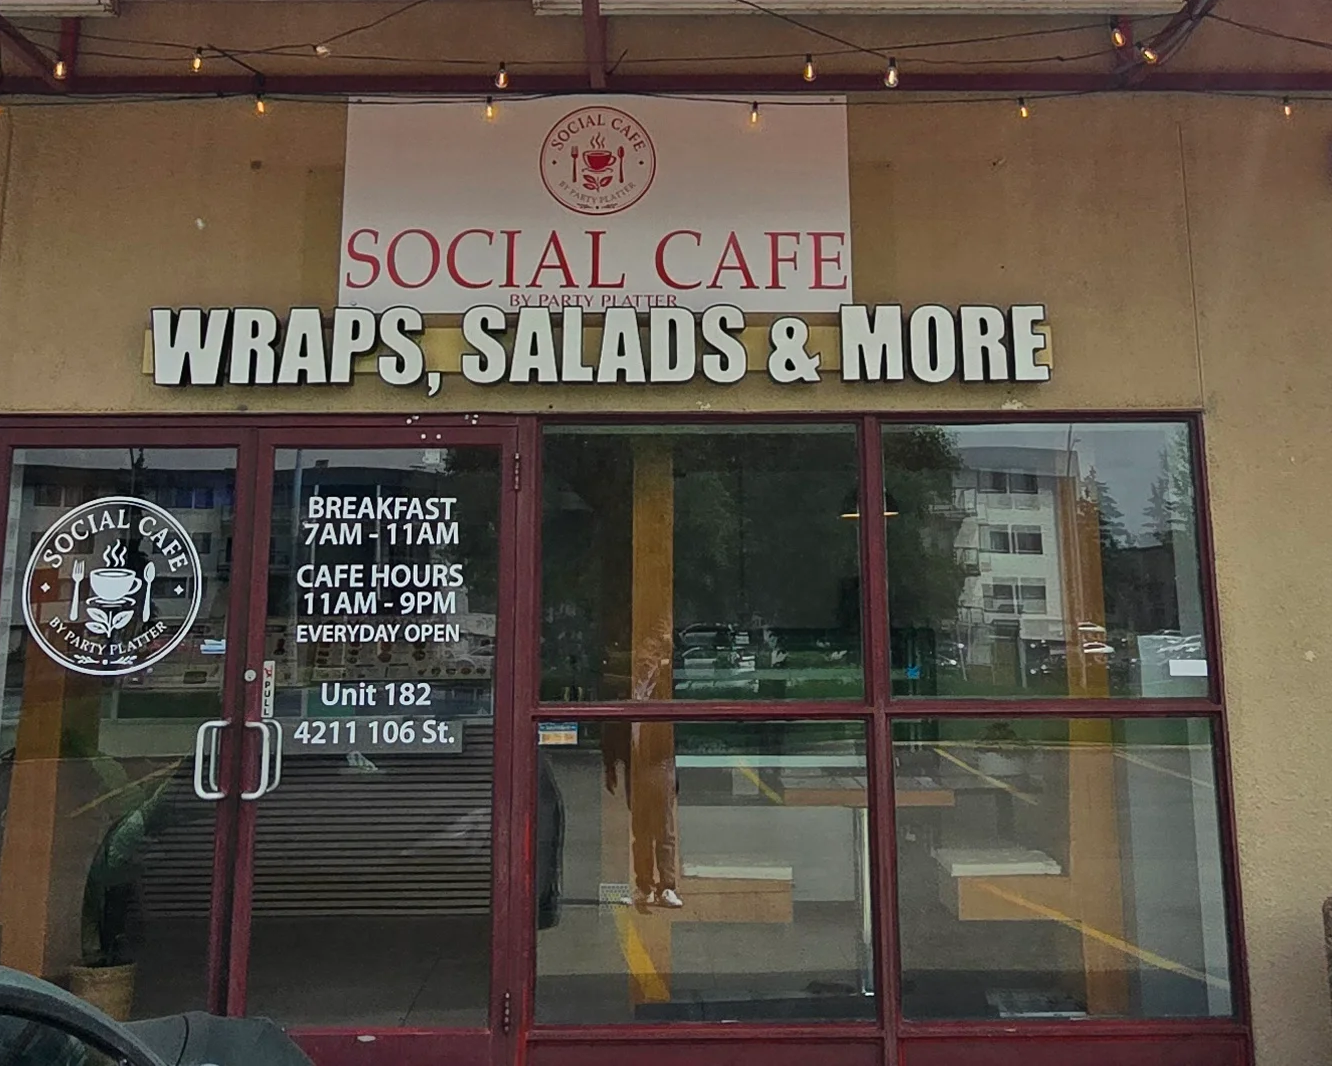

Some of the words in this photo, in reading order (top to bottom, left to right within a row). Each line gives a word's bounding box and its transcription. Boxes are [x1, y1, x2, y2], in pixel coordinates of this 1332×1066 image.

[551, 114, 606, 151] SOCIAL
[611, 118, 646, 152] CAFE
[570, 188, 598, 204] PARTY
[600, 181, 636, 203] PLATTER
[345, 228, 626, 290] SOCIAL
[655, 229, 850, 290] CAFE
[509, 294, 532, 307] BY
[539, 294, 594, 307] PARTY
[601, 294, 677, 307] PLATTER
[150, 307, 442, 396] WRAPS,
[462, 304, 747, 386] SALADS
[768, 316, 822, 384] &
[839, 304, 1049, 384] MORE
[308, 497, 457, 520] BREAKFAST
[43, 509, 130, 569] SOCIAL
[138, 516, 189, 573] CAFE
[304, 523, 363, 545] 7AM
[385, 522, 460, 545] 11AM
[296, 564, 363, 588] CAFE
[372, 564, 463, 588] HOURS
[304, 592, 377, 615] 11AM
[400, 592, 456, 615] 9PM
[48, 615, 66, 633] BY
[64, 627, 108, 656] PARTY
[110, 620, 169, 656] PLATTER
[296, 624, 400, 643] EVERYDAY
[405, 624, 461, 643] OPEN
[321, 683, 376, 707] Unit
[384, 683, 431, 706] 182
[294, 720, 357, 745] 4211
[369, 720, 416, 745] 106
[421, 720, 456, 745] St.
